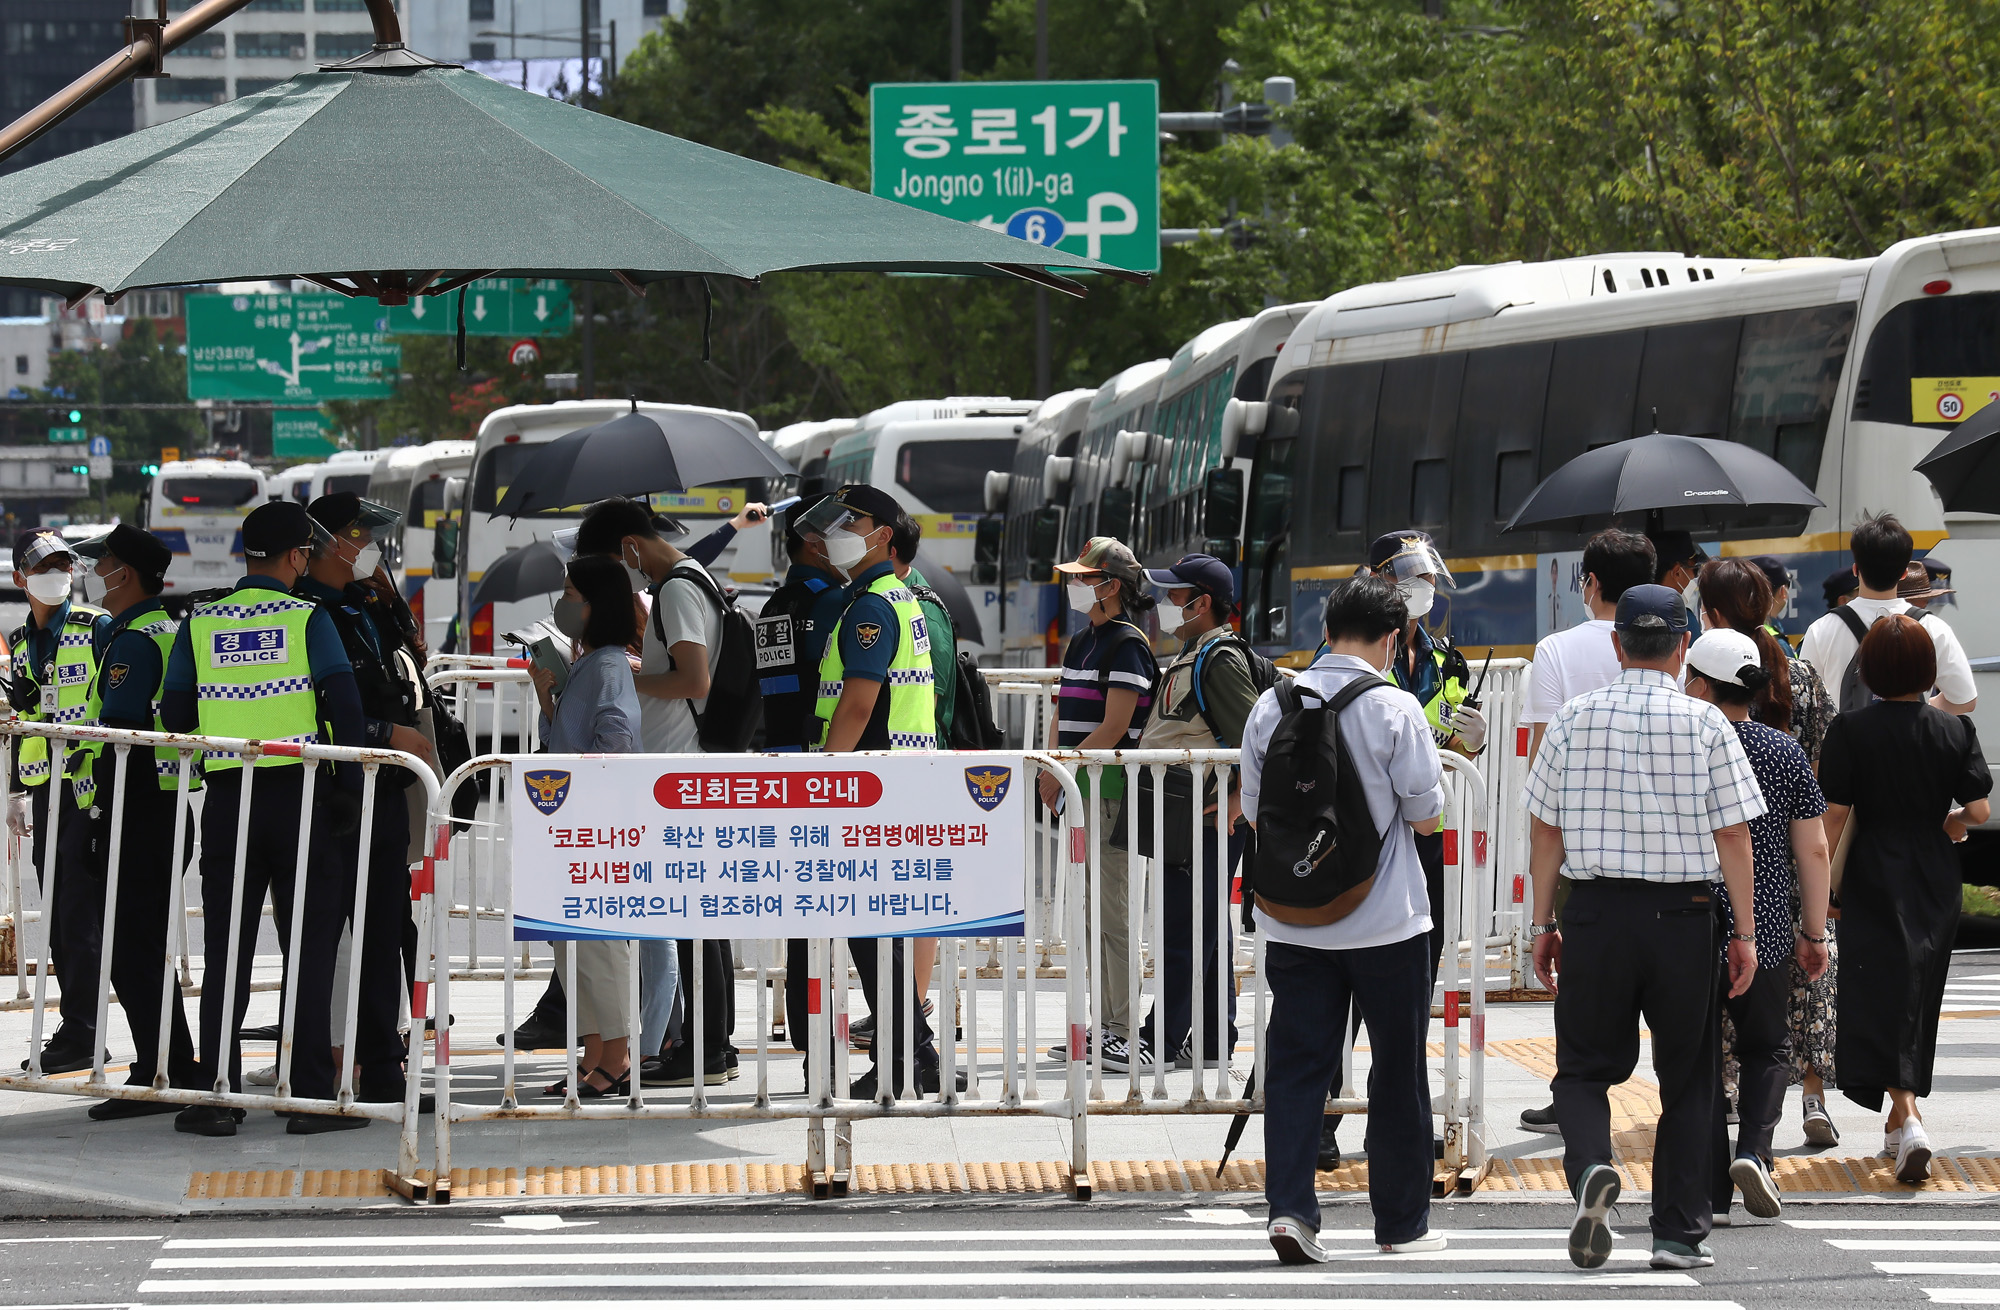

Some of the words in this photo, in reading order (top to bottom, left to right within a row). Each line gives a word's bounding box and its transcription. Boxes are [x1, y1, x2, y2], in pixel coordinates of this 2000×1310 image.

[895, 101, 1128, 160] 종로1가
[894, 168, 984, 205] Jongno
[992, 167, 1074, 204] 1(il)-ga
[1025, 214, 1047, 245] 6
[1943, 401, 1957, 412] 50
[220, 651, 279, 664] POLICE
[758, 649, 791, 663] POLICE
[61, 676, 85, 685] POLICE
[677, 778, 787, 805] 집회금지
[805, 777, 859, 803] 안내
[662, 826, 704, 849] 확산
[715, 825, 778, 848] 방지를
[789, 825, 829, 847] 위해
[841, 824, 988, 847] 감염병예방법과
[568, 861, 652, 884] 집시법에
[665, 861, 706, 883] 따라
[890, 858, 954, 881] 집회를
[562, 895, 687, 918] 금지하였으니
[700, 894, 782, 918] 협조하여
[794, 893, 856, 916] 주시기
[868, 893, 958, 916] 바랍니다.
